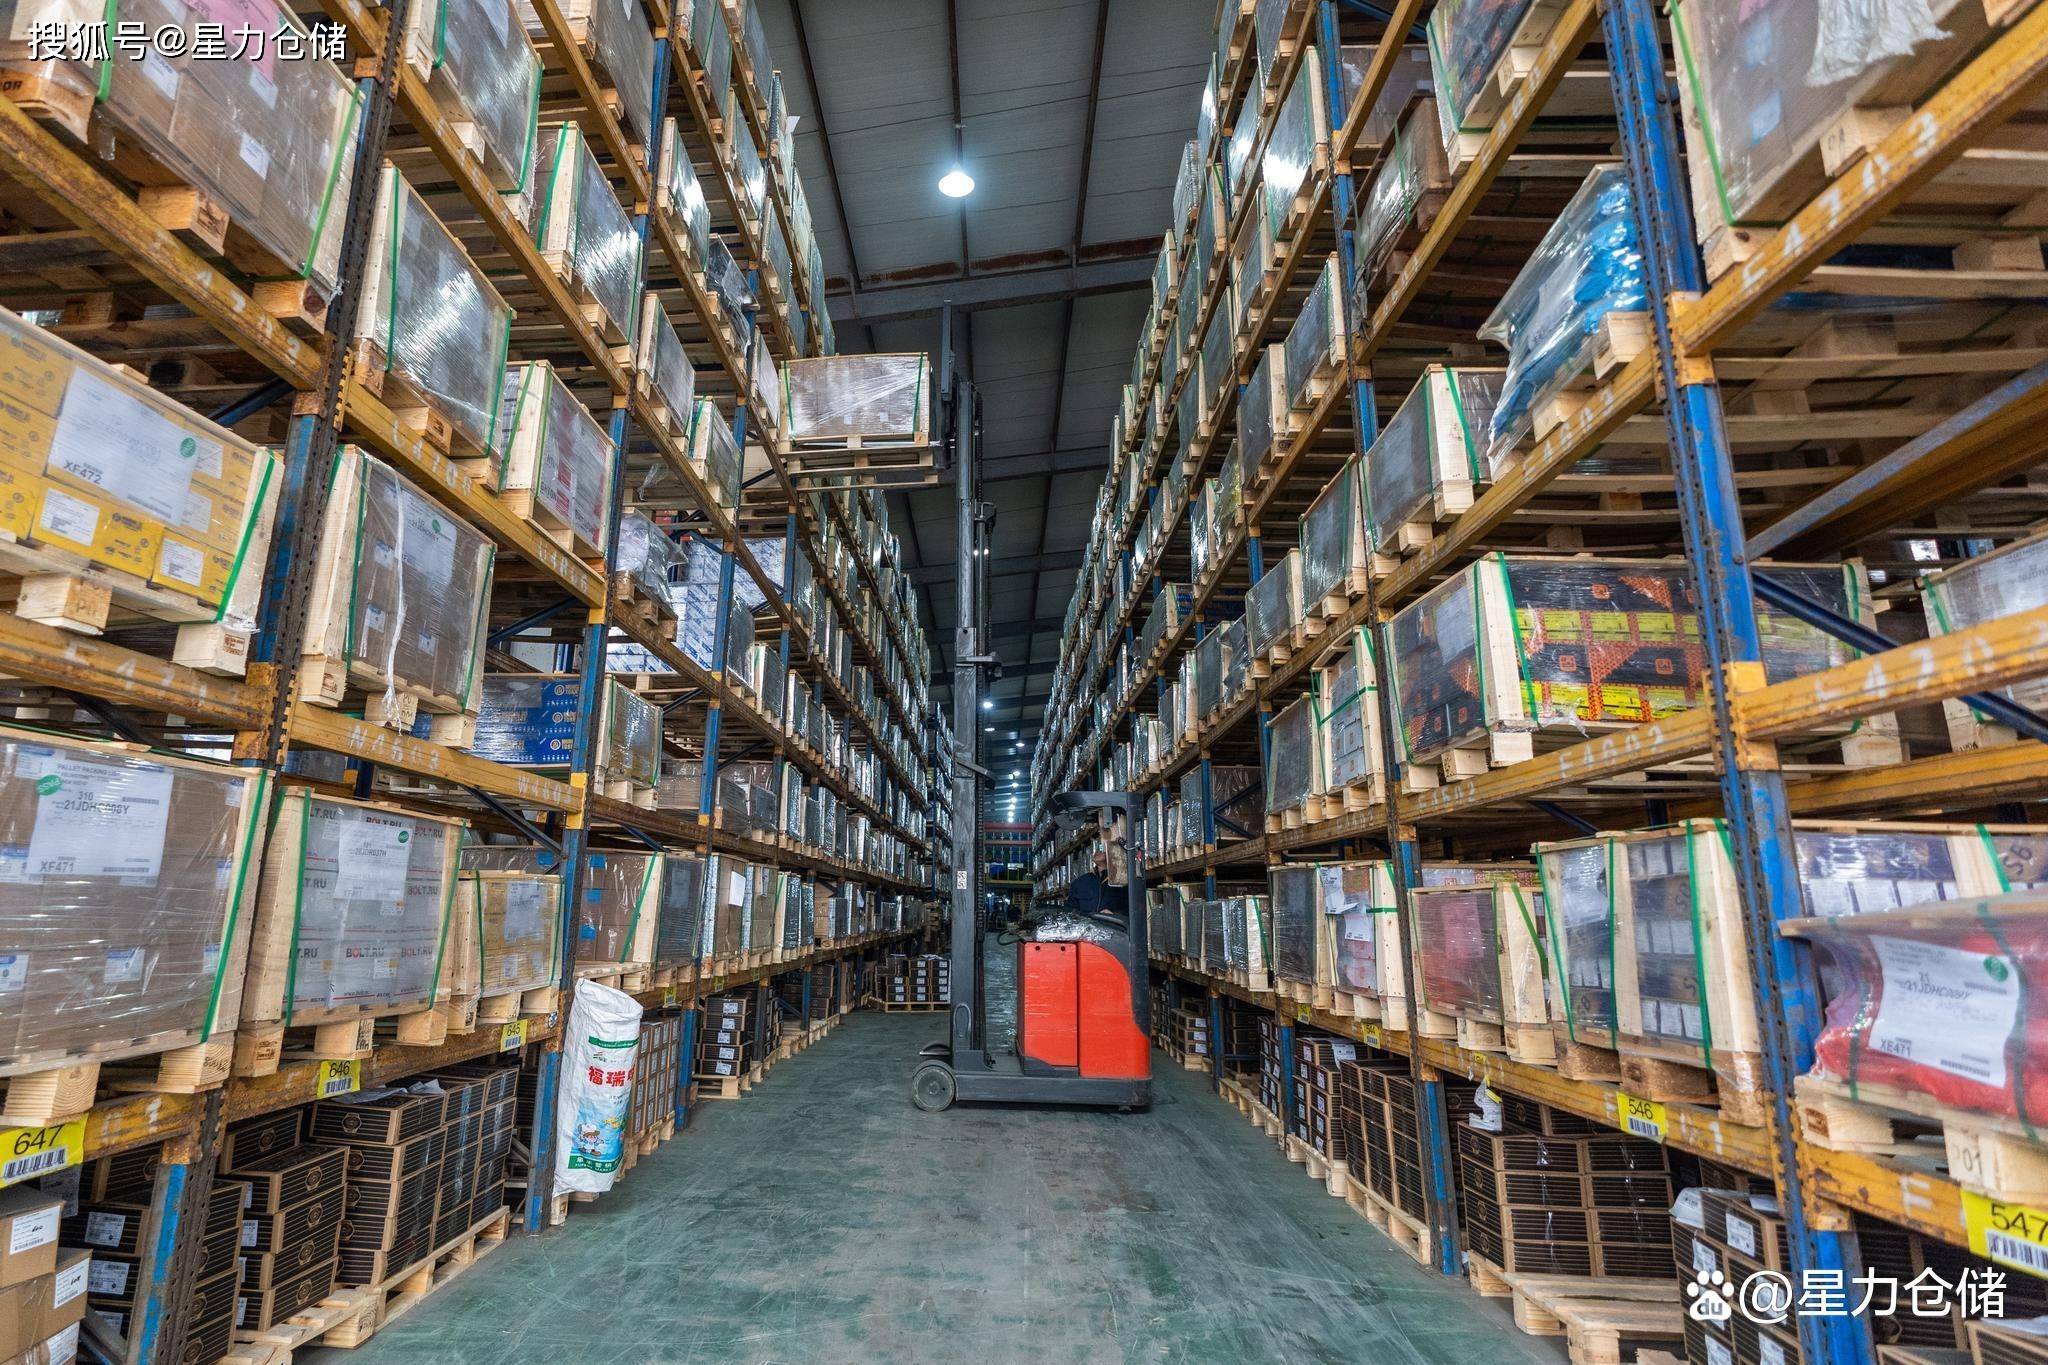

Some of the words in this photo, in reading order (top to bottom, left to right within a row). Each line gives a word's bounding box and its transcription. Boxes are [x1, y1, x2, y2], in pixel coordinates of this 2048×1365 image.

[63, 459, 103, 486] XF472
[329, 1061, 351, 1077] 646
[1628, 1098, 1654, 1120] 546
[14, 1126, 65, 1156] 647
[1990, 1204, 2048, 1242] 547
